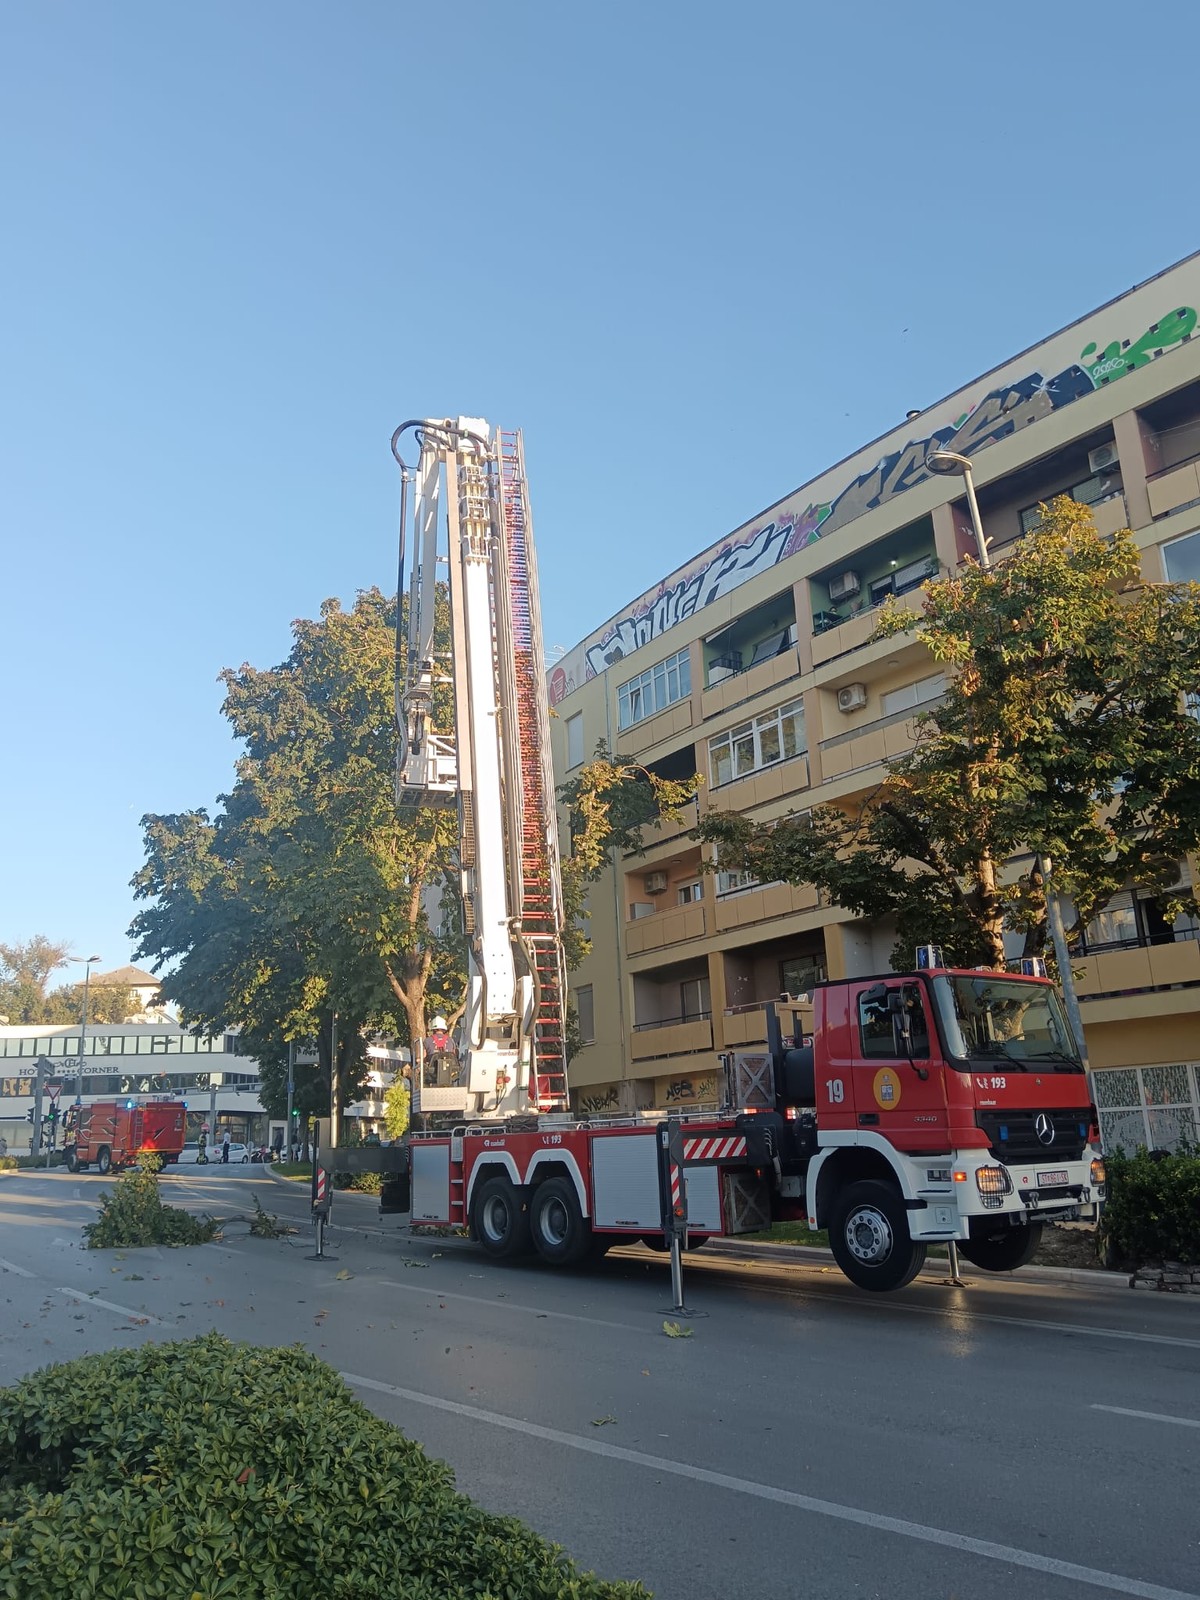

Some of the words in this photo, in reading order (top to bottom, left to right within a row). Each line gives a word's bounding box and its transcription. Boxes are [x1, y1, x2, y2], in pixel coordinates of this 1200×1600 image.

[991, 1076, 1006, 1089] 193
[826, 1079, 844, 1103] 19
[551, 1135, 562, 1145] 193
